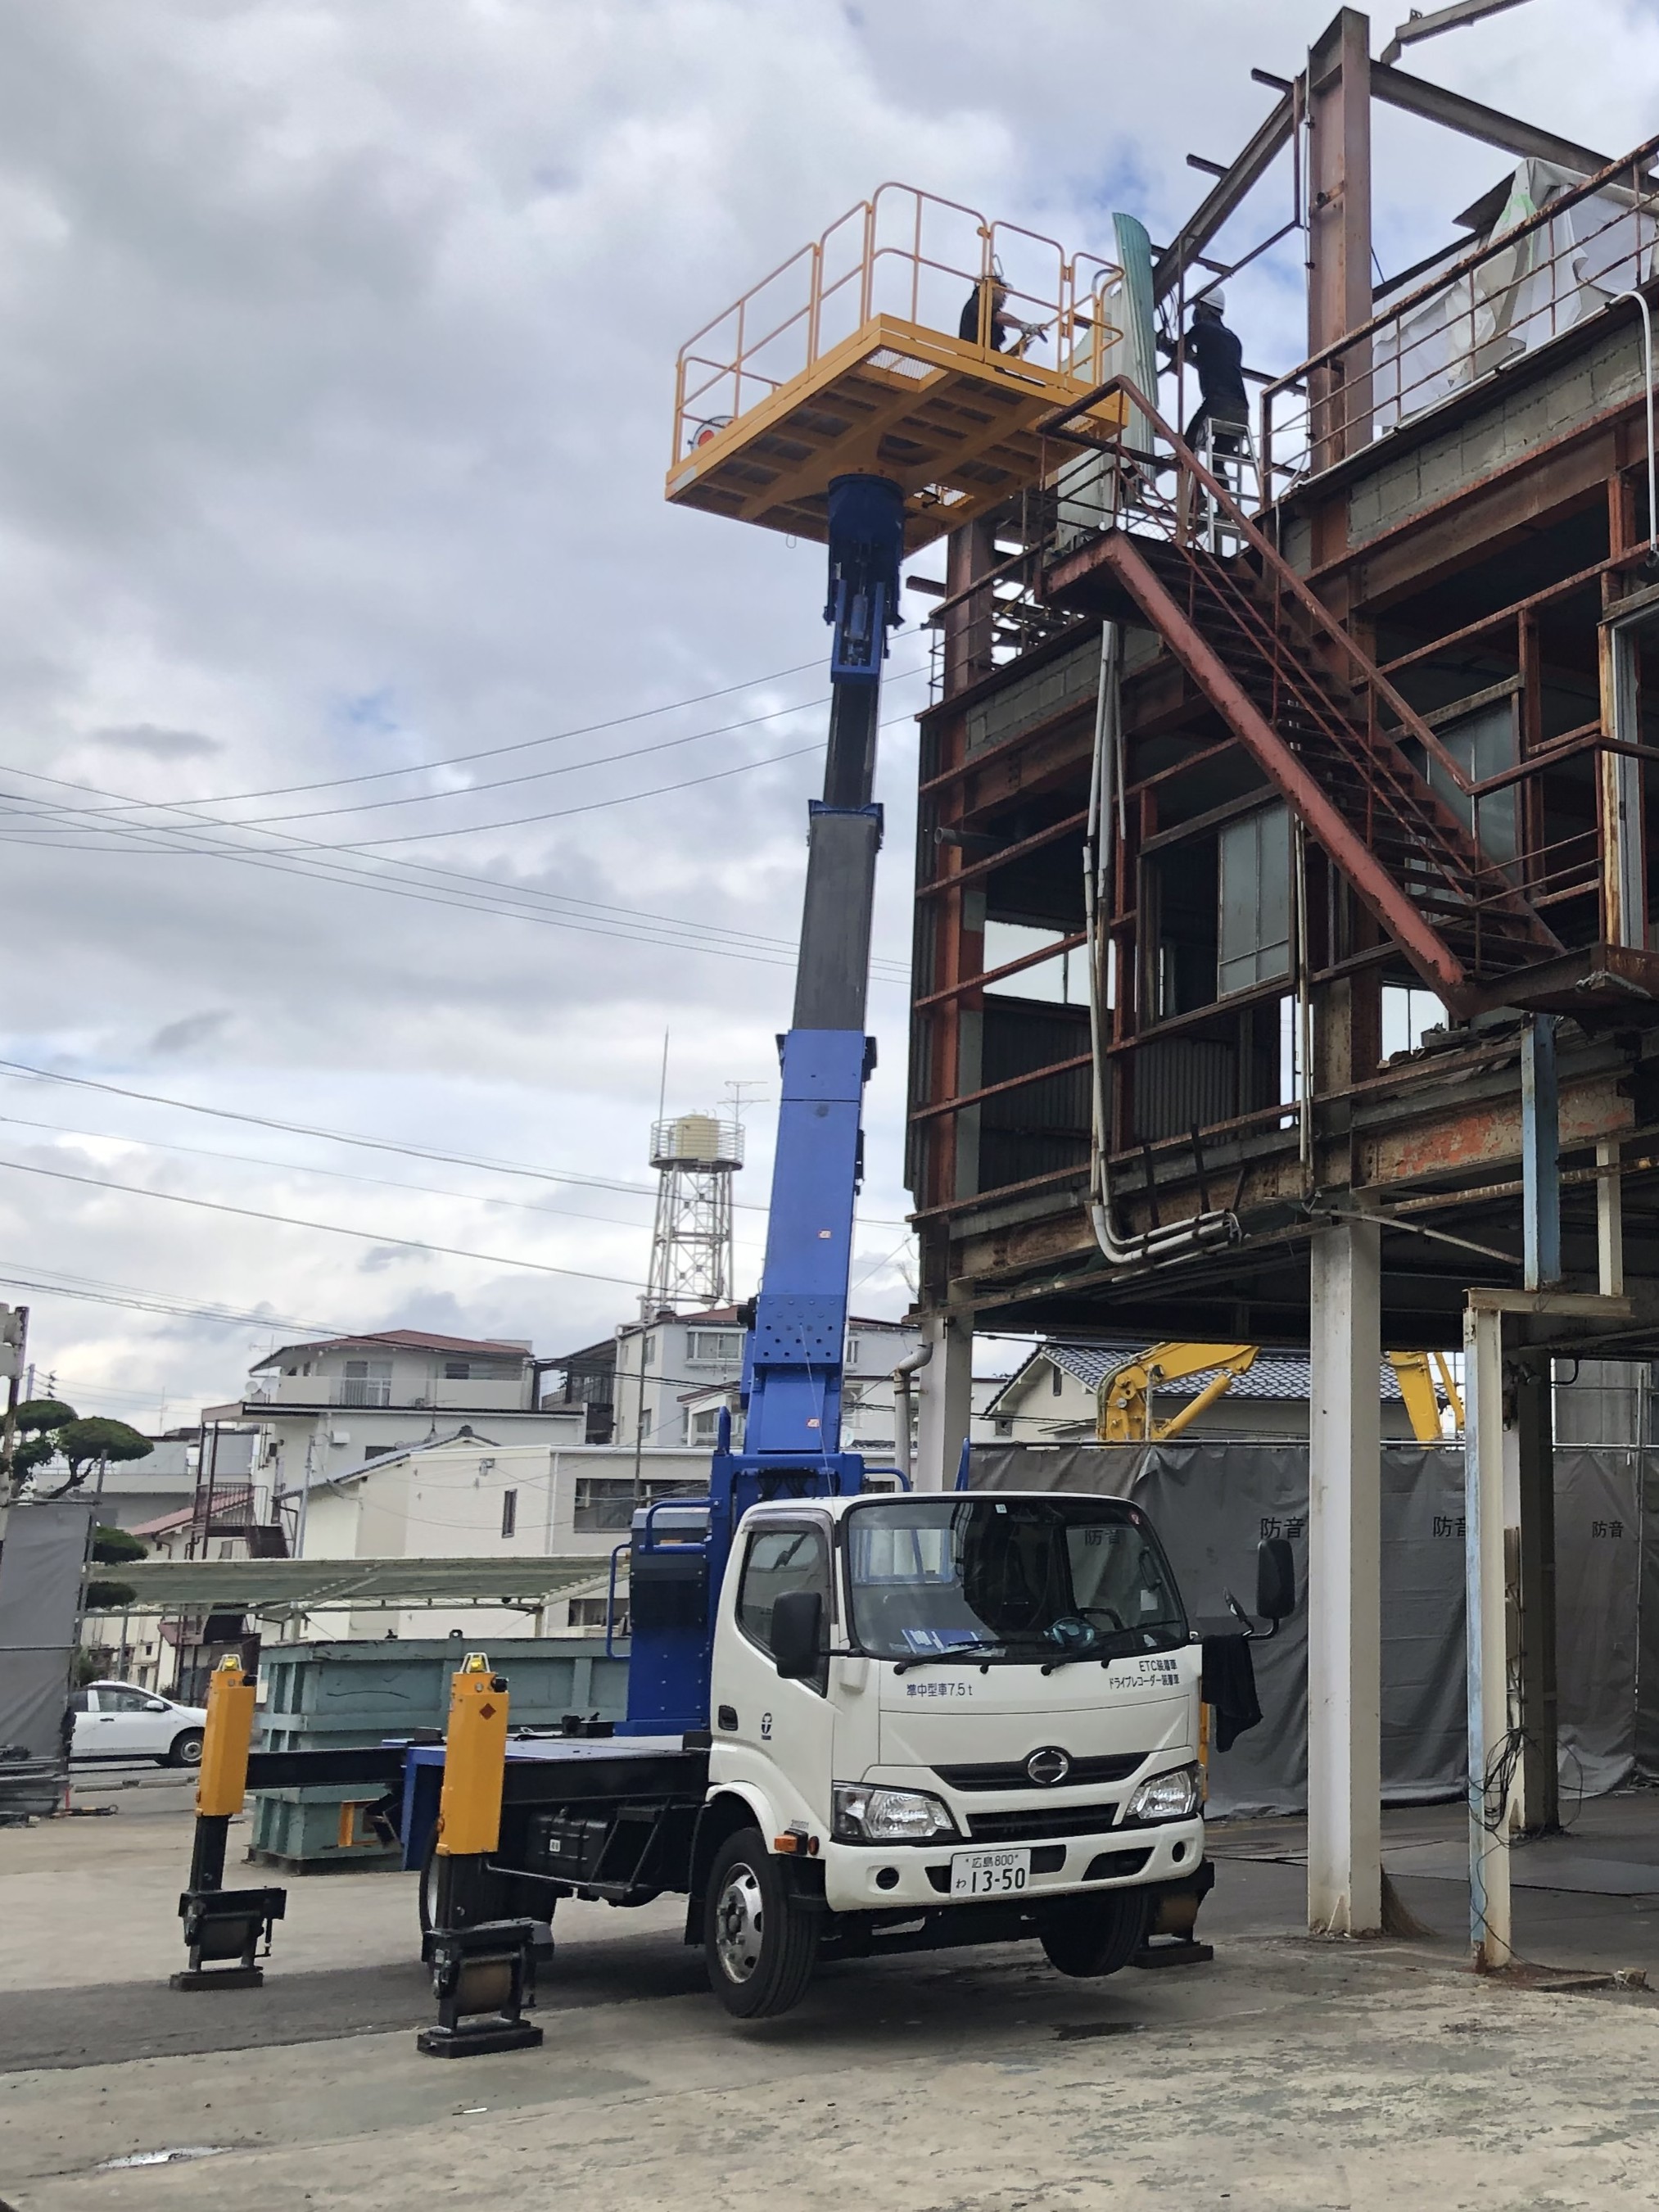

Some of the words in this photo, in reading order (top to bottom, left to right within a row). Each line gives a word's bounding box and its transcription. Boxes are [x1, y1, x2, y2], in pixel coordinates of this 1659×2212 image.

[1260, 1516, 1305, 1539] 防音
[1592, 1520, 1624, 1538] 防音
[956, 1879, 966, 1889] わ
[972, 1867, 1025, 1893] 13-50
